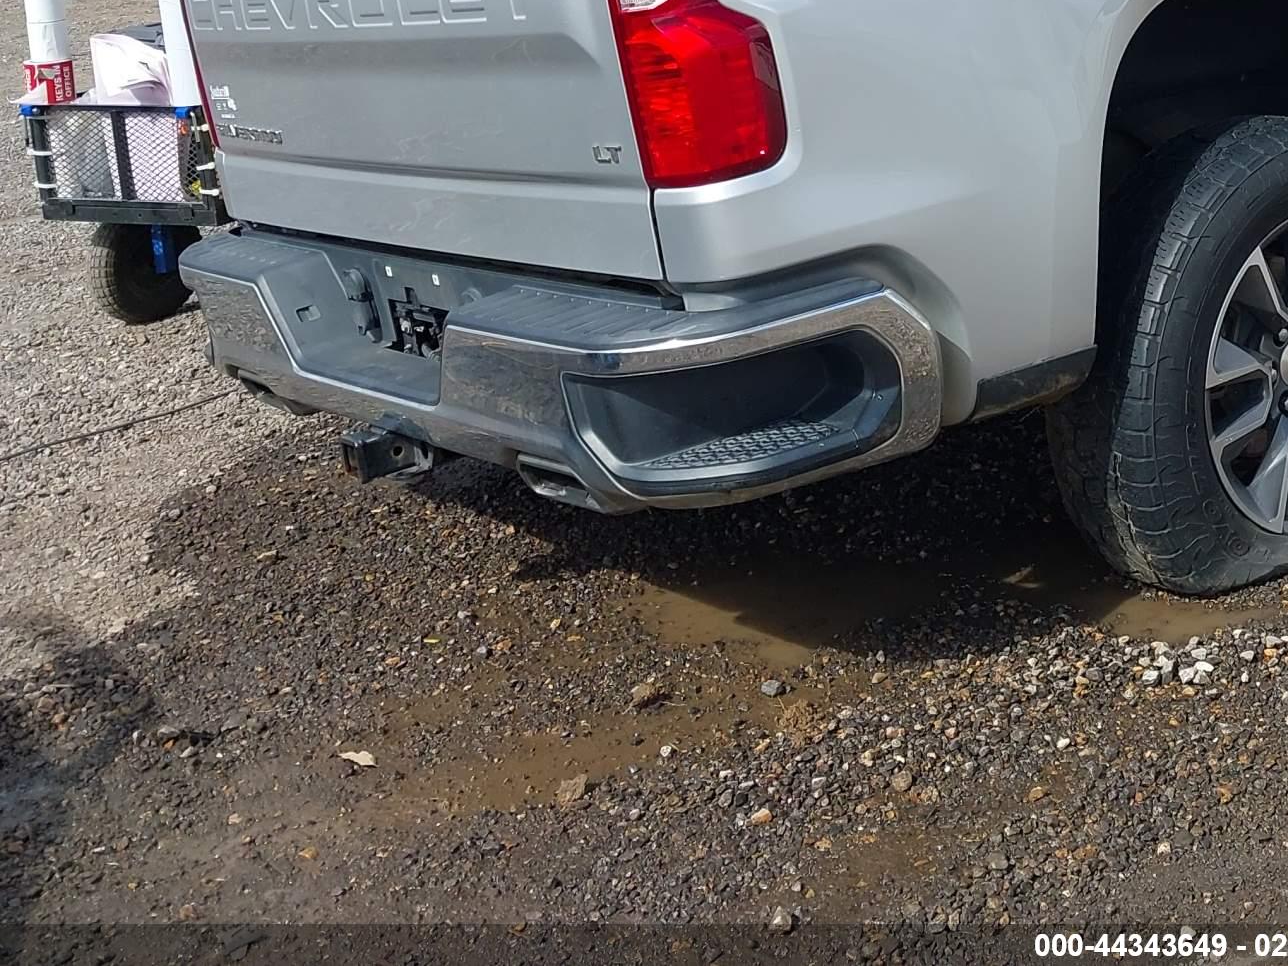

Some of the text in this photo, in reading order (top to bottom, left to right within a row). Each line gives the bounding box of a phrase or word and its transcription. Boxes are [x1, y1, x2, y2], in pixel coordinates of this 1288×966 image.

[54, 77, 64, 102] KEYS
[63, 66, 73, 98] OFFICE
[592, 145, 622, 164] LT
